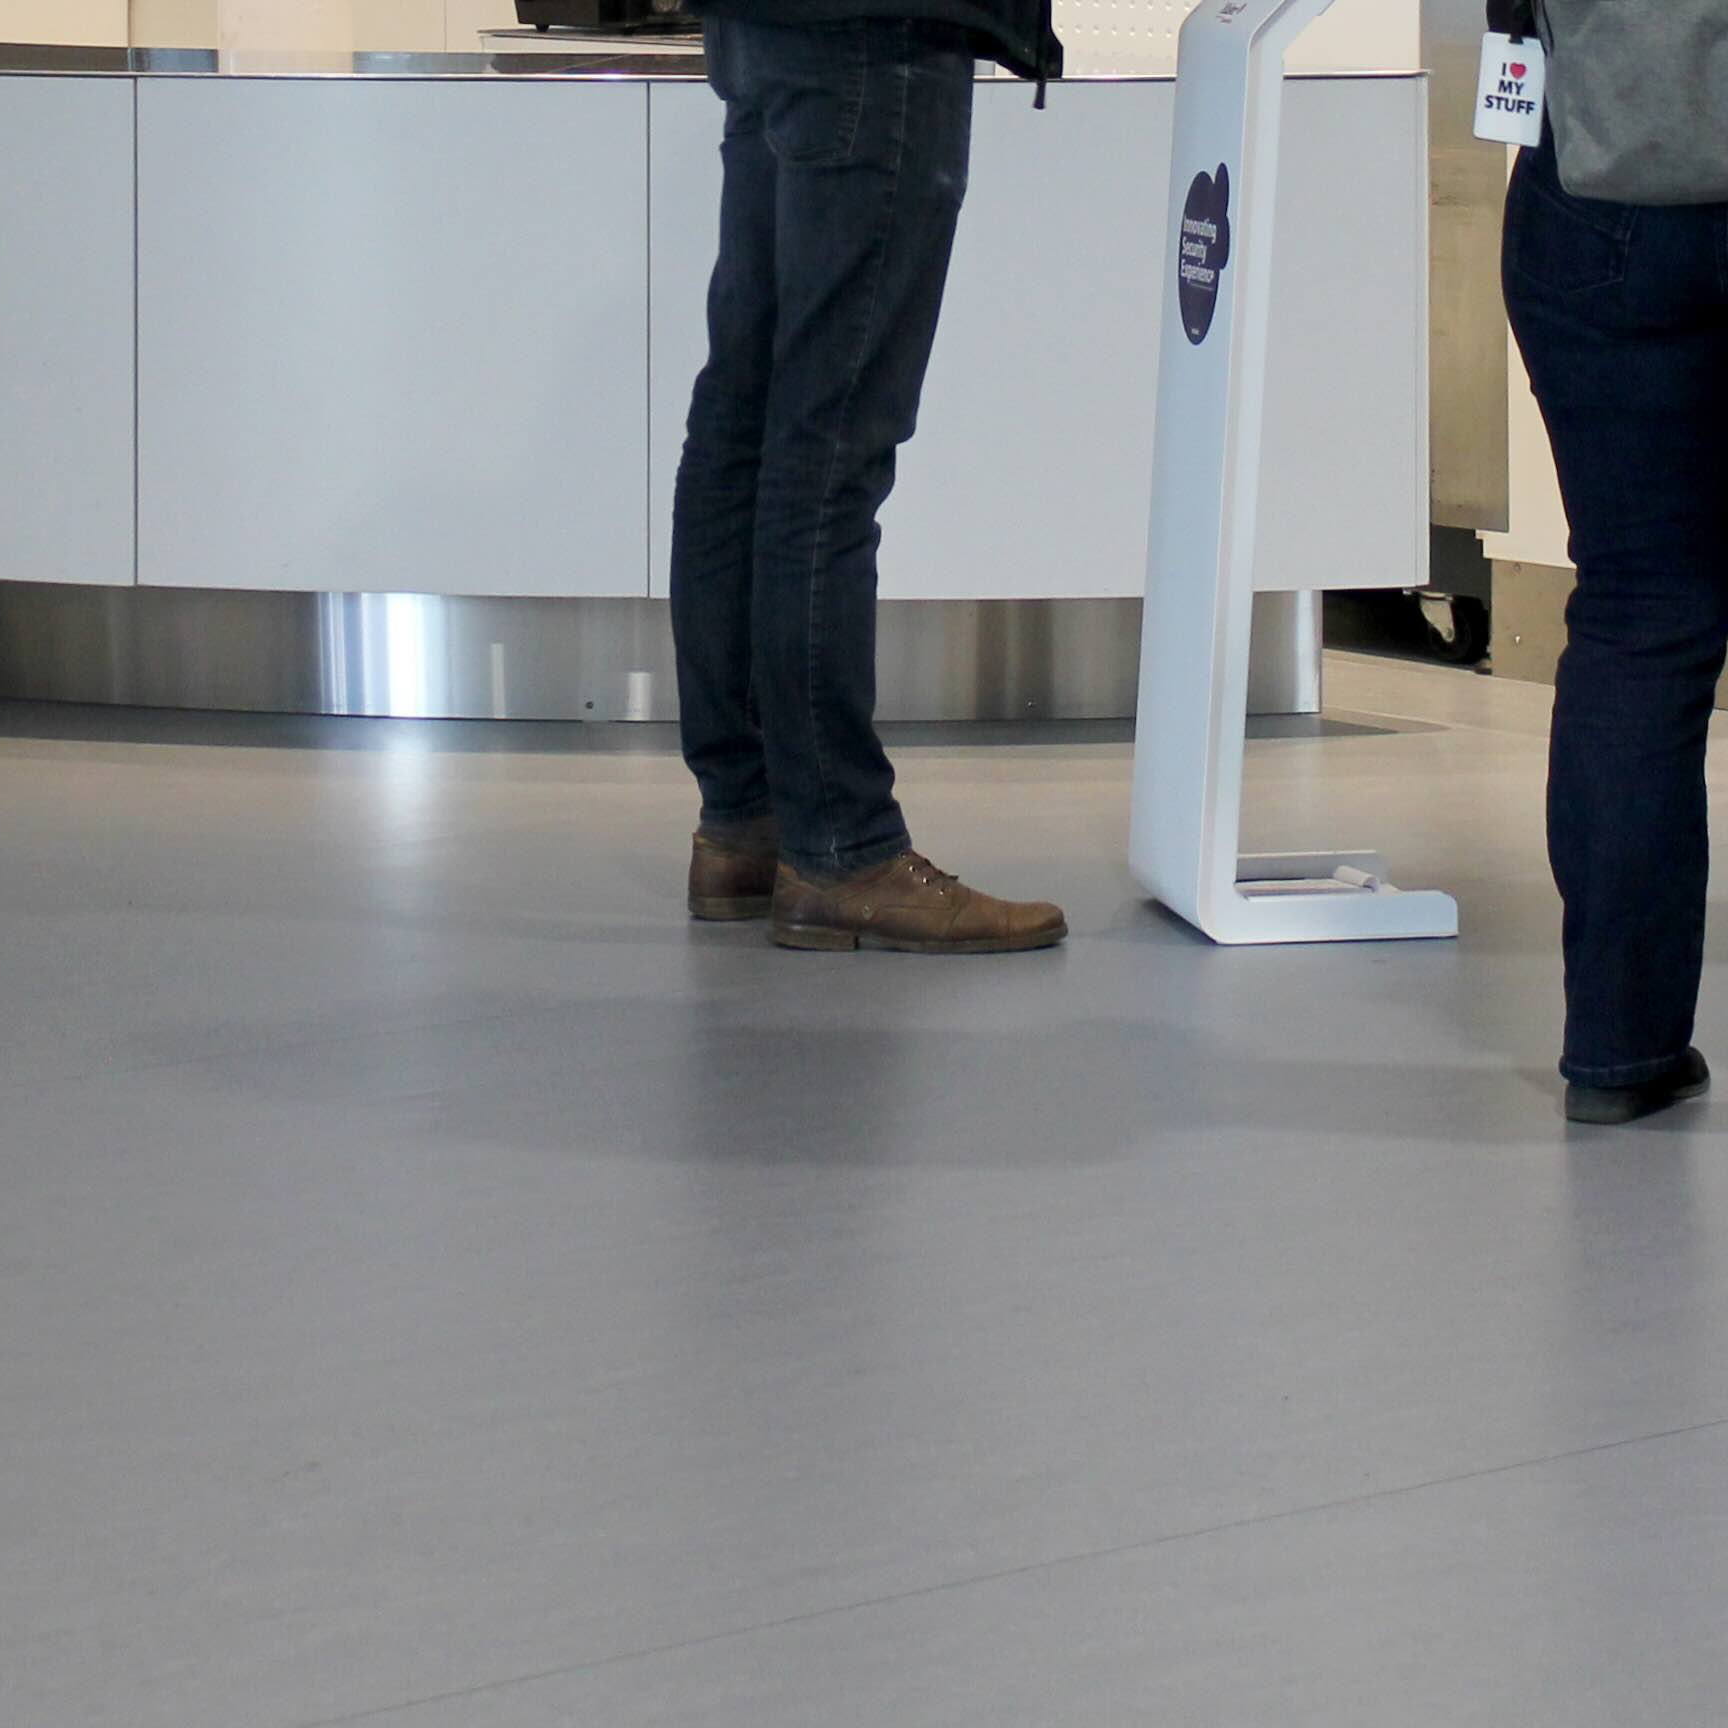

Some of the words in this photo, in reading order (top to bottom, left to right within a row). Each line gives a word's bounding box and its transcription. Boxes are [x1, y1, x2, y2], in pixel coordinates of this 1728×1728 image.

[1501, 62, 1507, 76] I
[1498, 79, 1524, 95] MY
[1484, 94, 1536, 115] STUFF
[1182, 236, 1208, 265] Security
